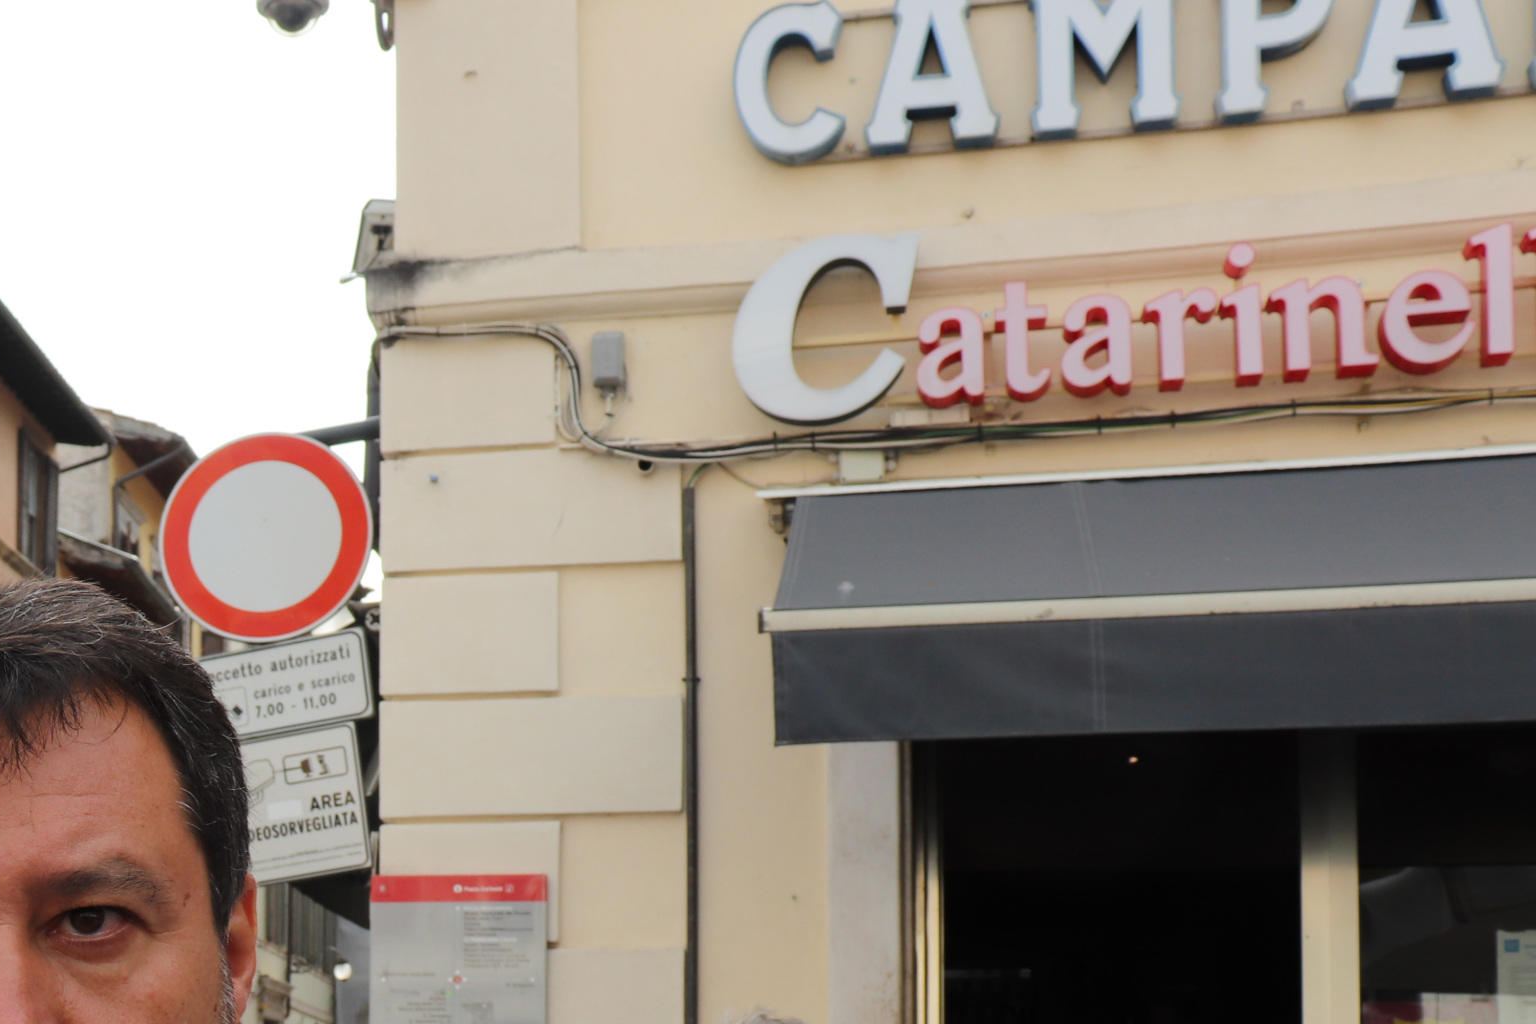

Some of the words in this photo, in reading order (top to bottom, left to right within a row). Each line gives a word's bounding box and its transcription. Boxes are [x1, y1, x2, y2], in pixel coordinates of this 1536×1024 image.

[732, 0, 1536, 167] CAMPA
[732, 222, 1536, 426] Catarinel
[270, 643, 351, 672] autorizzati
[254, 680, 292, 700] carico
[297, 681, 305, 692] e
[311, 672, 356, 689] scarico
[255, 702, 285, 719] 7.00
[310, 790, 356, 812] AREA
